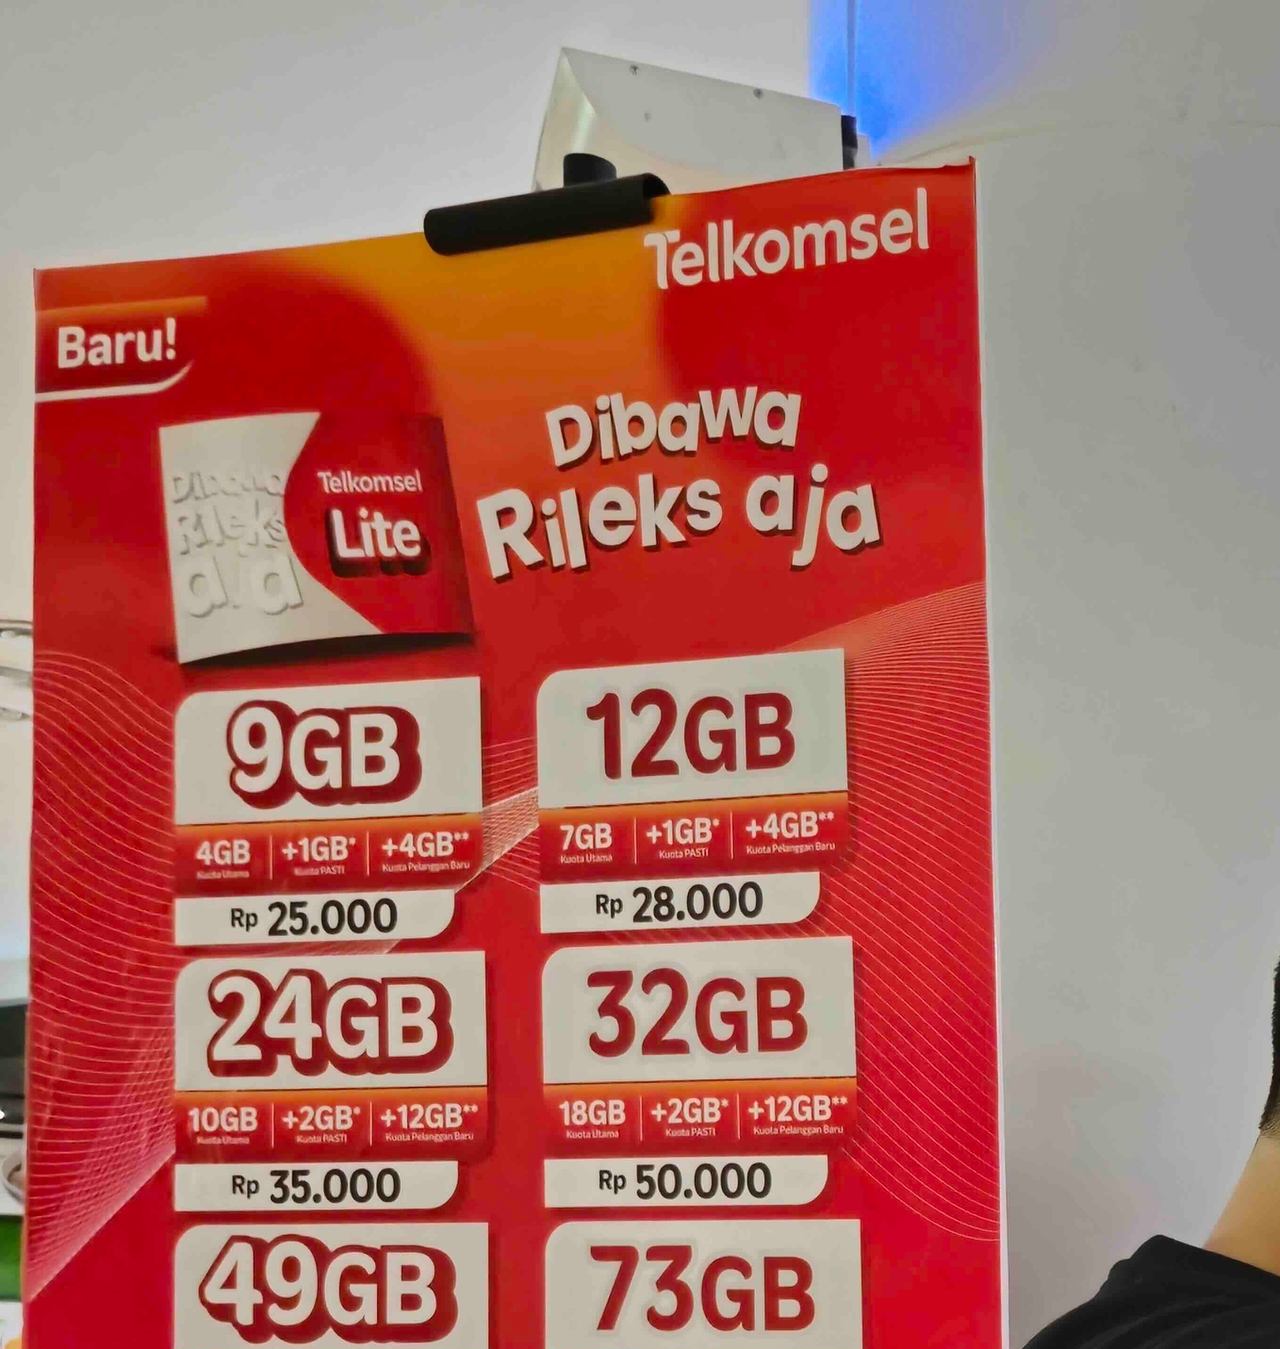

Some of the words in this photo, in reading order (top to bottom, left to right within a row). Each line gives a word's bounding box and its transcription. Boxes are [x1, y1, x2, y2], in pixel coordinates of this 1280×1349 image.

[644, 188, 928, 290] Telkomsel
[57, 318, 177, 369] Baru!
[545, 386, 802, 468] Dibawa
[317, 468, 423, 494] Telkomsel
[330, 509, 422, 561] Lite
[475, 473, 723, 581] Rileks
[745, 463, 883, 568] aja
[230, 701, 401, 794] 9GB
[586, 689, 796, 780] 12GB
[196, 839, 250, 865] 4GB
[559, 823, 612, 851] 7GB
[559, 854, 587, 865] Kuota
[588, 853, 613, 863] Utama
[230, 908, 258, 932] Rp
[268, 899, 396, 936] 25.000
[595, 893, 623, 918] Rp
[632, 883, 763, 923] 28.000
[208, 970, 440, 1062] 24GB
[587, 969, 808, 1058] 32GB
[558, 1100, 626, 1126] 18GB
[231, 1175, 259, 1197] Rp
[269, 1169, 400, 1205] 35.000
[598, 1170, 626, 1193] Rp
[636, 1164, 772, 1200] 50.000
[203, 1240, 439, 1327] 49GB
[590, 1244, 815, 1331] 73GB
